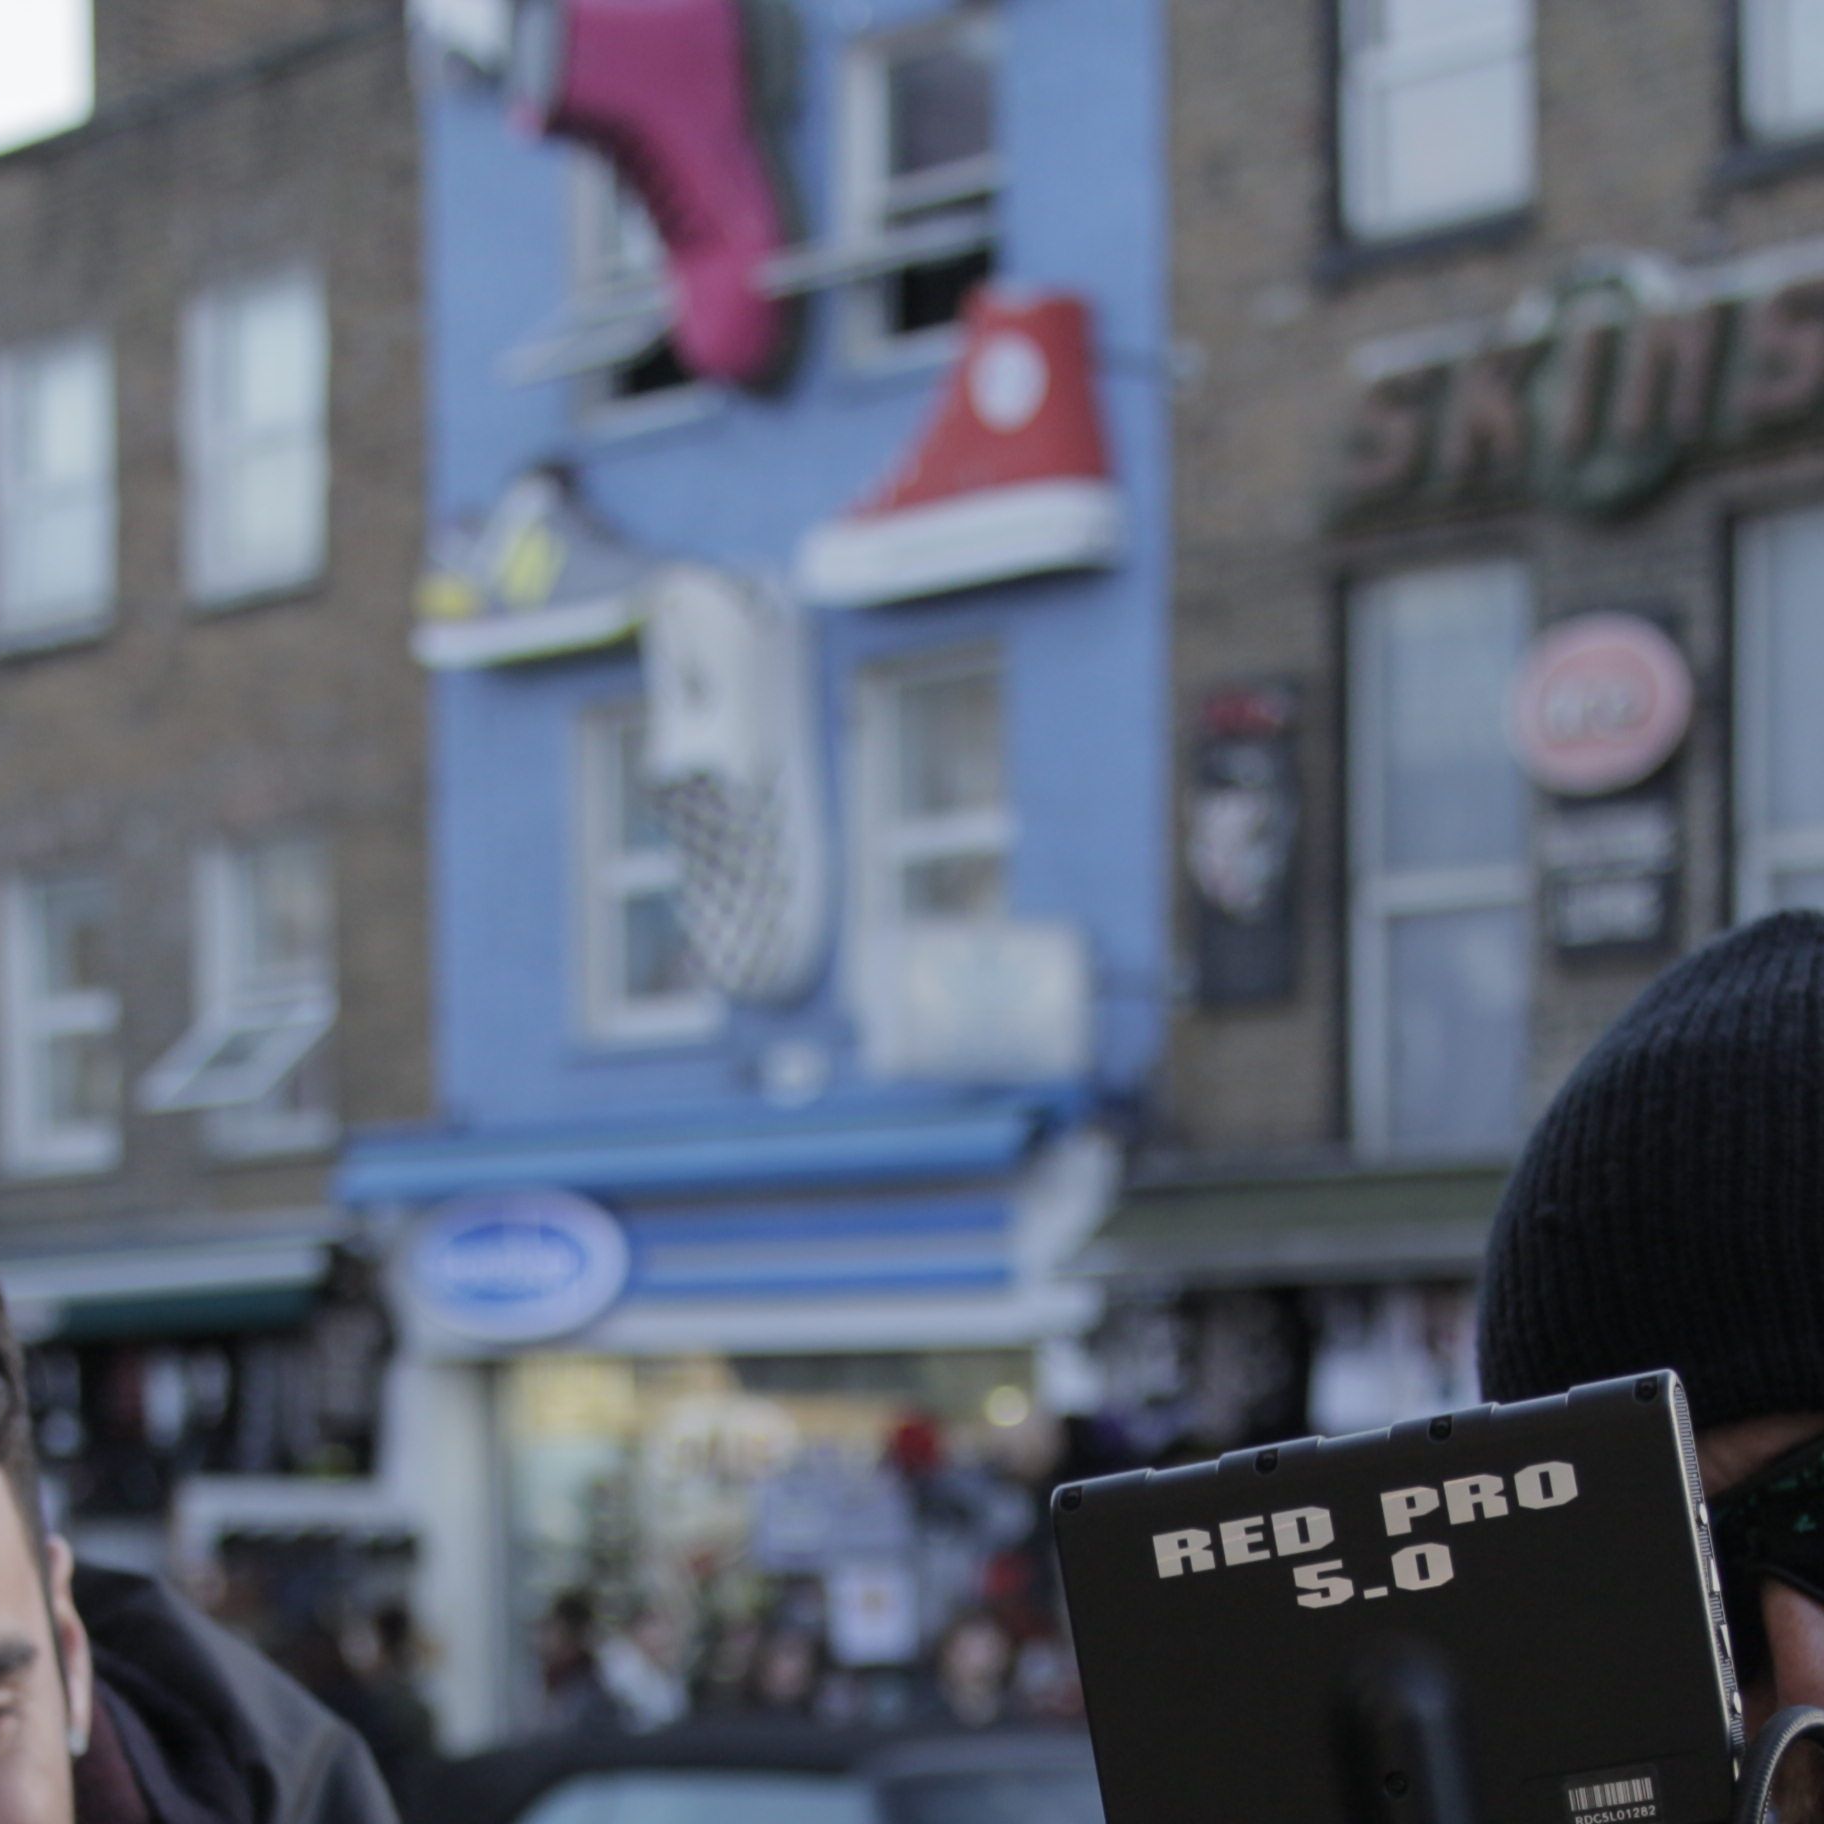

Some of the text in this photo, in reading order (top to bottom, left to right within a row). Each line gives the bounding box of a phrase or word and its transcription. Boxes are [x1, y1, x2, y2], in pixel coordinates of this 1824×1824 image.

[1152, 1460, 1578, 1579] RED PRO
[1292, 1542, 1455, 1609] 5.0
